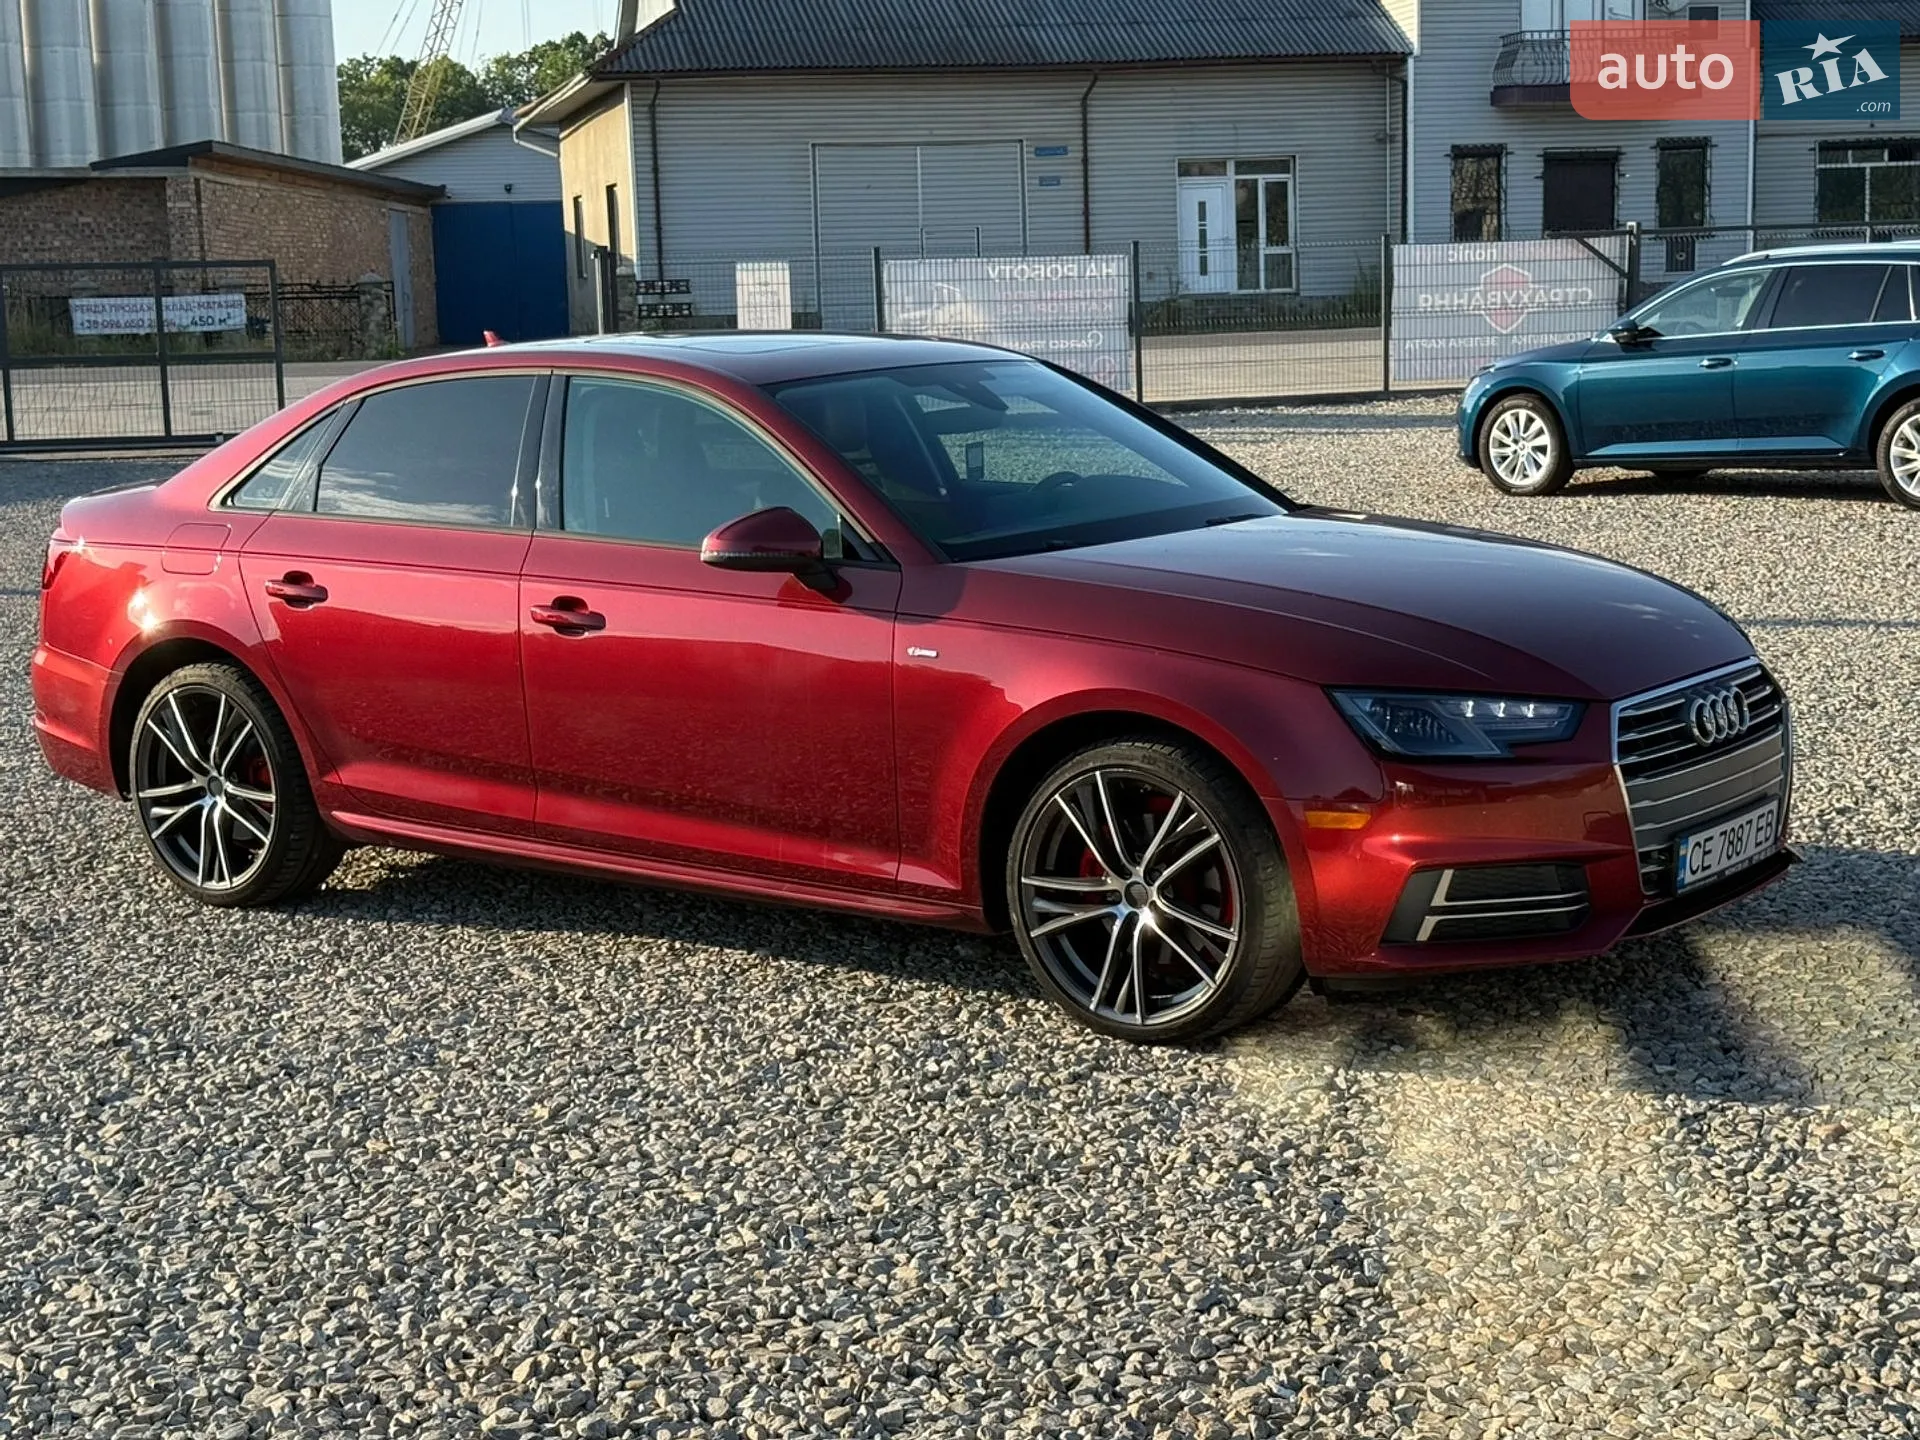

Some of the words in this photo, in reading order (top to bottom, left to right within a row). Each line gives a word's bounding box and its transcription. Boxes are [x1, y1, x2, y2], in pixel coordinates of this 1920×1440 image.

[163, 300, 243, 313] КЛАД-МАГАЗИН
[190, 315, 215, 327] 450
[1689, 835, 1714, 875] CE
[1717, 818, 1754, 866] 7887
[1755, 808, 1775, 848] EB
